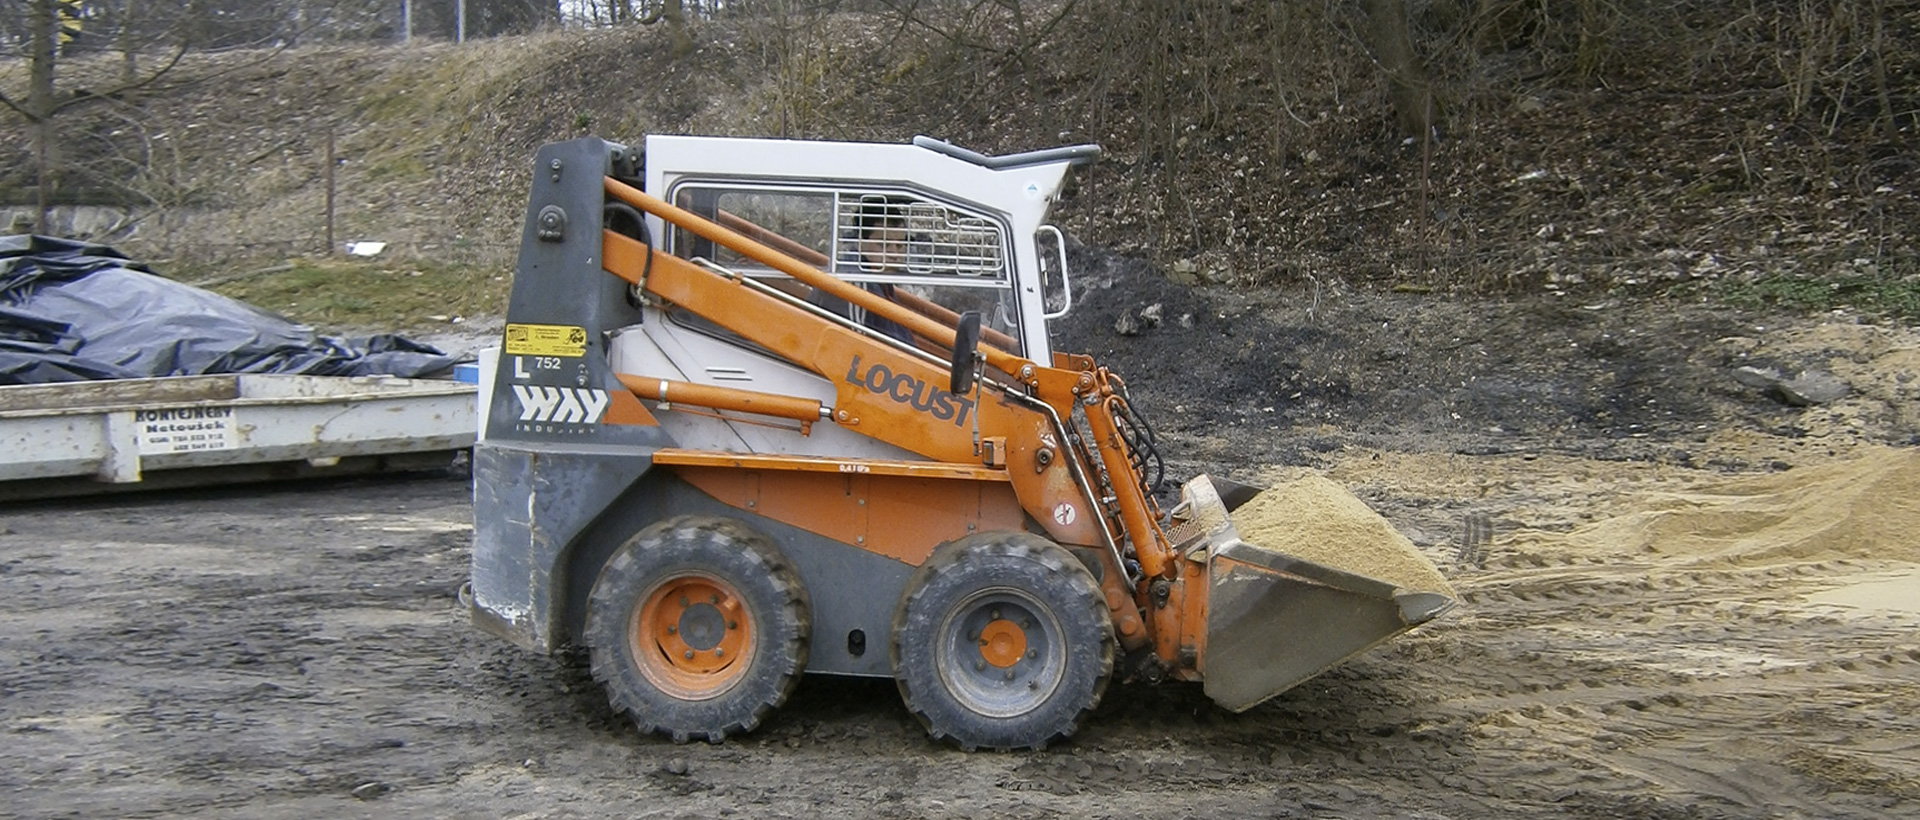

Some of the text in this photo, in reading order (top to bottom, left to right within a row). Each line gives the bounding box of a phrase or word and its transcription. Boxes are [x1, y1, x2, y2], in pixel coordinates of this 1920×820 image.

[514, 356, 561, 379] L 752
[512, 384, 609, 424] WAY
[845, 354, 975, 428] LOCUST
